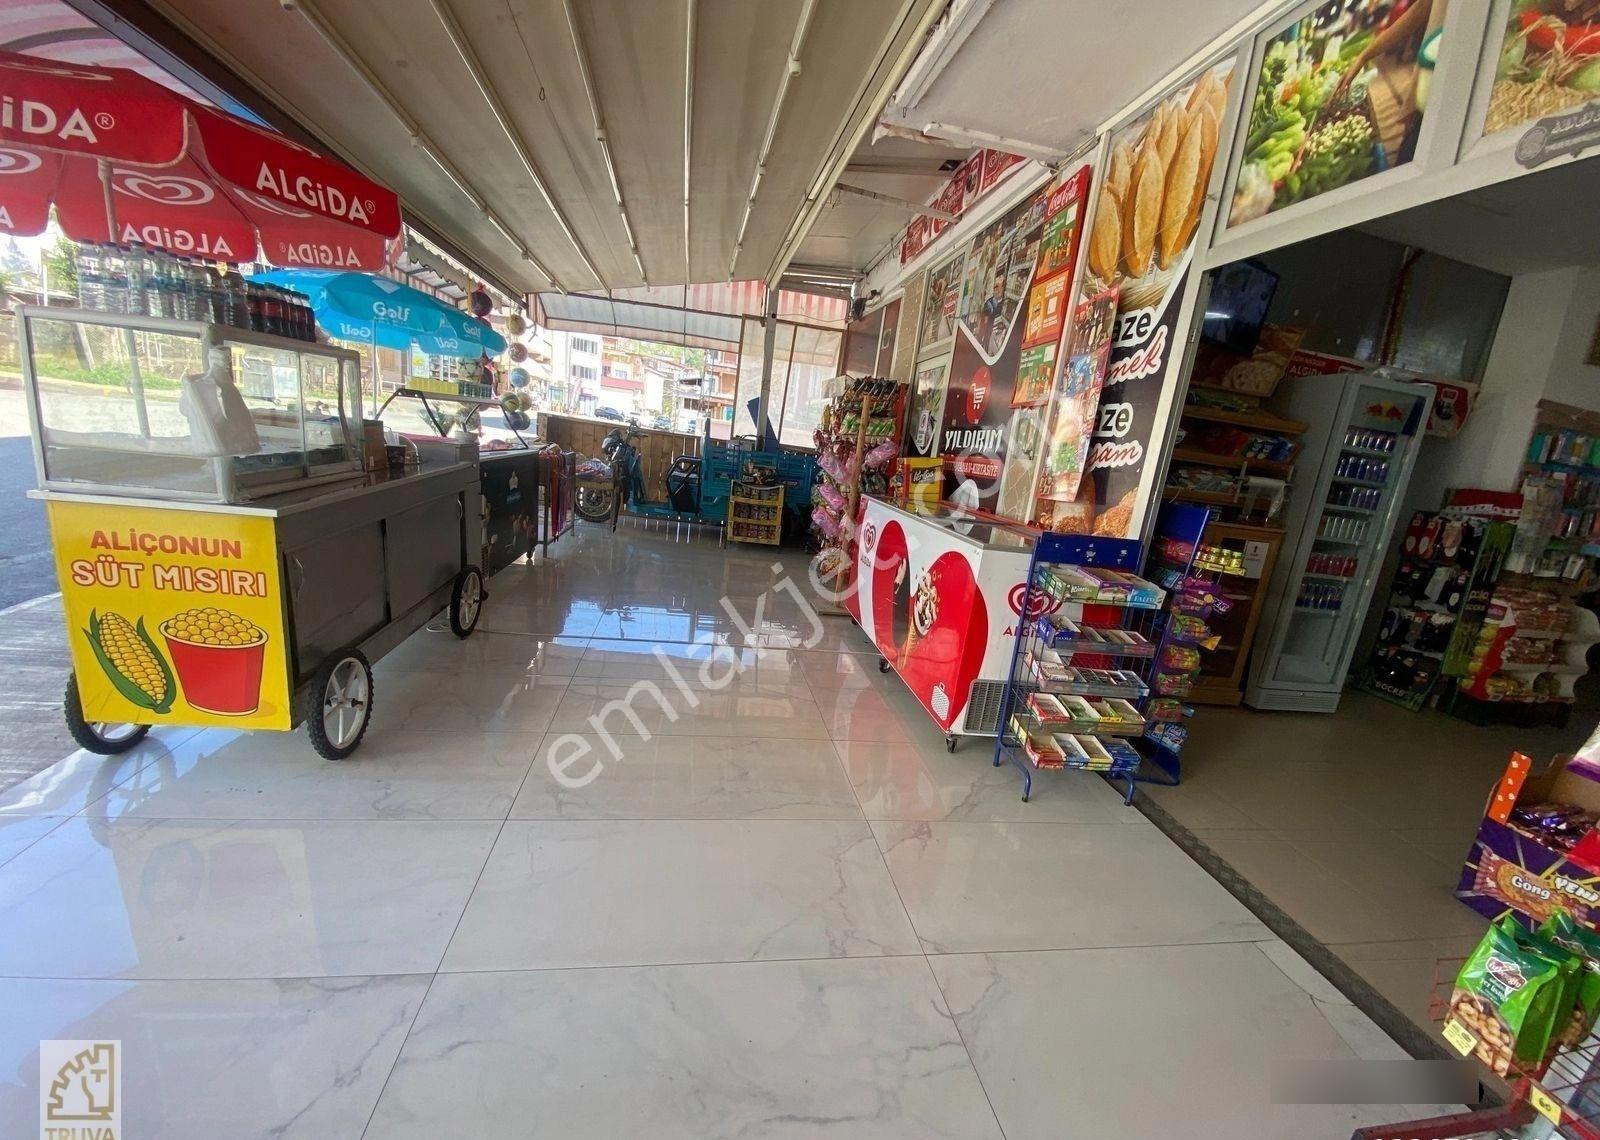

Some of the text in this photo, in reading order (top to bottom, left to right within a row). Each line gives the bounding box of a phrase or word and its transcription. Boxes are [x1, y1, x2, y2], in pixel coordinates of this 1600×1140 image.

[373, 301, 411, 322] Golf
[463, 322, 481, 338] Golf
[945, 429, 1003, 453] YILDIRIM
[90, 528, 242, 559] ALİÇONUN
[71, 554, 267, 598] SÜT MISIRI
[1511, 875, 1550, 900] Gong
